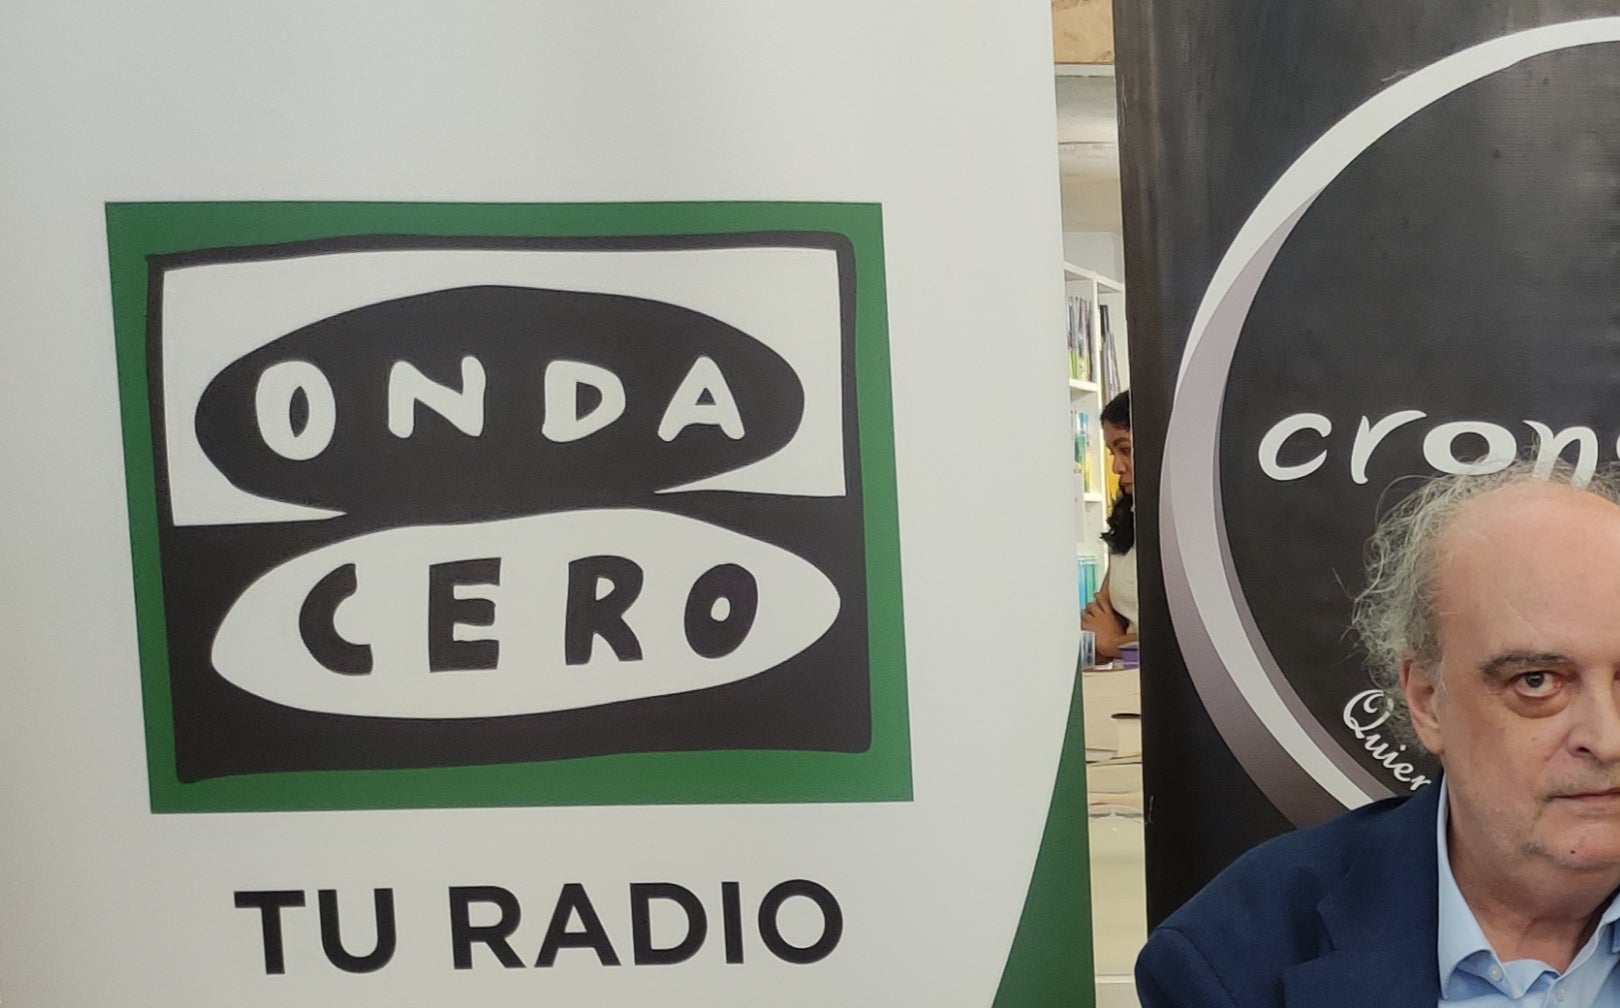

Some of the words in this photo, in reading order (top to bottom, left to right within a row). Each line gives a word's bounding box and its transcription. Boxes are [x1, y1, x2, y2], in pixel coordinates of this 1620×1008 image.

[255, 354, 745, 461] ONDA
[298, 554, 759, 676] CERO
[234, 888, 397, 975] TU
[448, 878, 844, 970] RADIO
